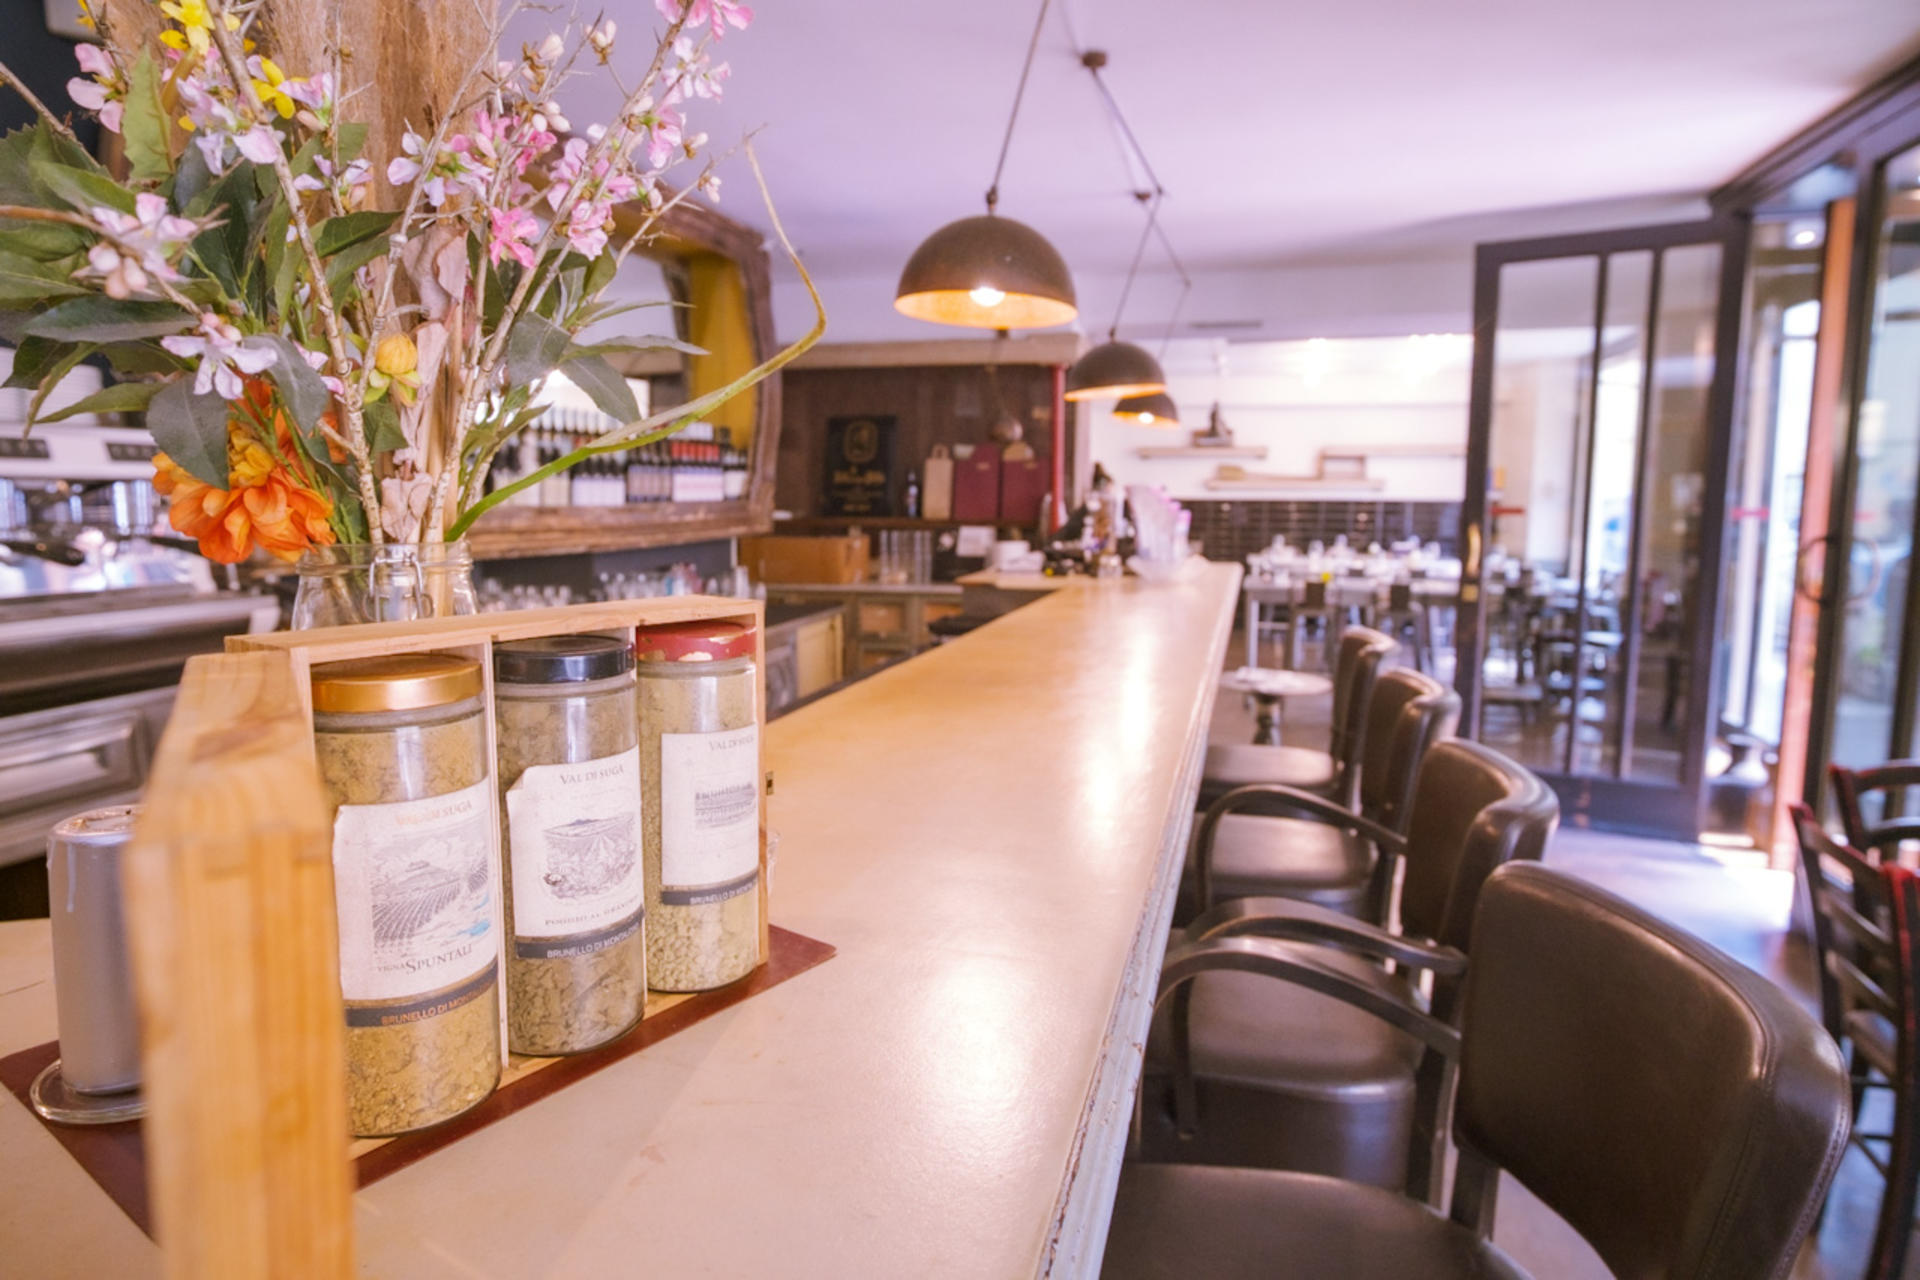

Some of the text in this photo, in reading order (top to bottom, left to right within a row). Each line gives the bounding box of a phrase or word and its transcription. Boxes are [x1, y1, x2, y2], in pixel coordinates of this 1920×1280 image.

[560, 764, 624, 785] VAL DI SUGA
[442, 800, 473, 817] SUGA
[405, 943, 473, 974] SPUNTALI
[547, 943, 593, 959] BRUNELLO
[594, 941, 602, 953] DI
[381, 1003, 448, 1026] BRUNELLO DI
